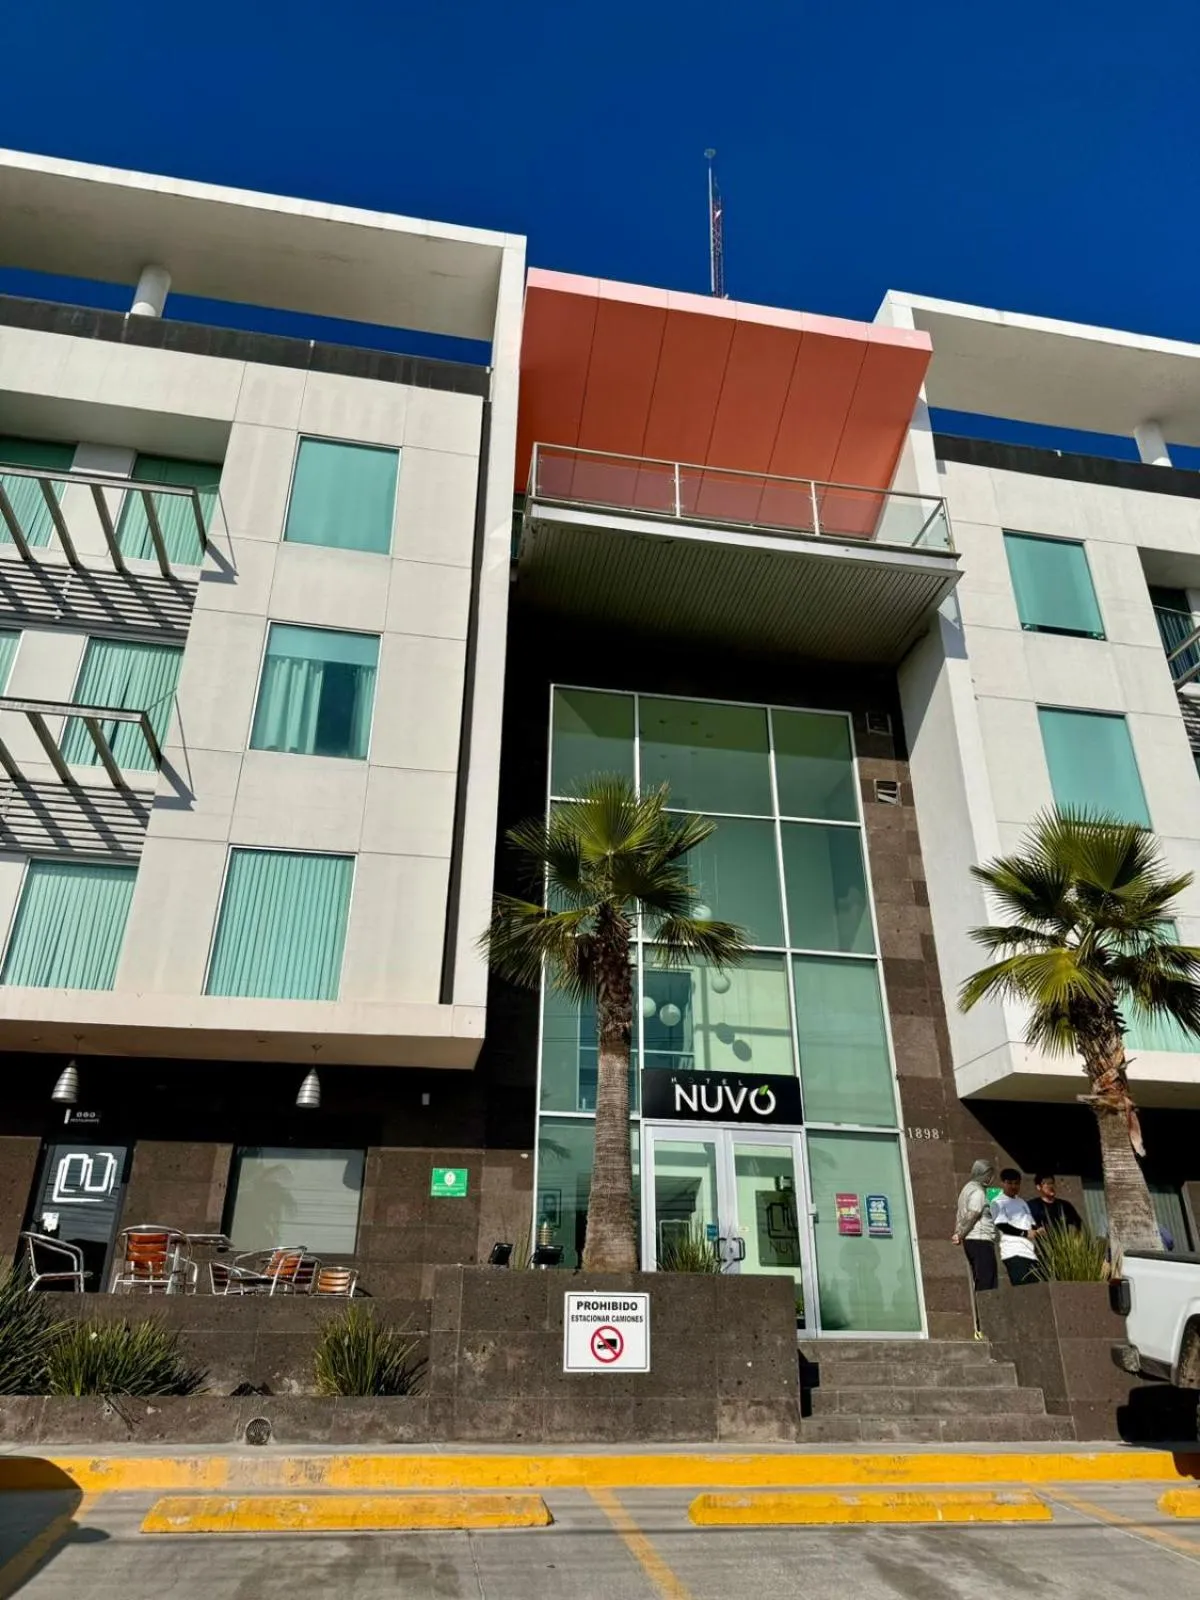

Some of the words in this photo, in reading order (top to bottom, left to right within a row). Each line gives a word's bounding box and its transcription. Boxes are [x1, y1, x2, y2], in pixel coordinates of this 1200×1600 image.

[675, 1084, 776, 1115] NUVO
[908, 1127, 940, 1139] 1898
[576, 1301, 638, 1311] PROHIBIDO
[571, 1314, 610, 1322] ESTACIONAR
[611, 1315, 643, 1323] CAMIONES
